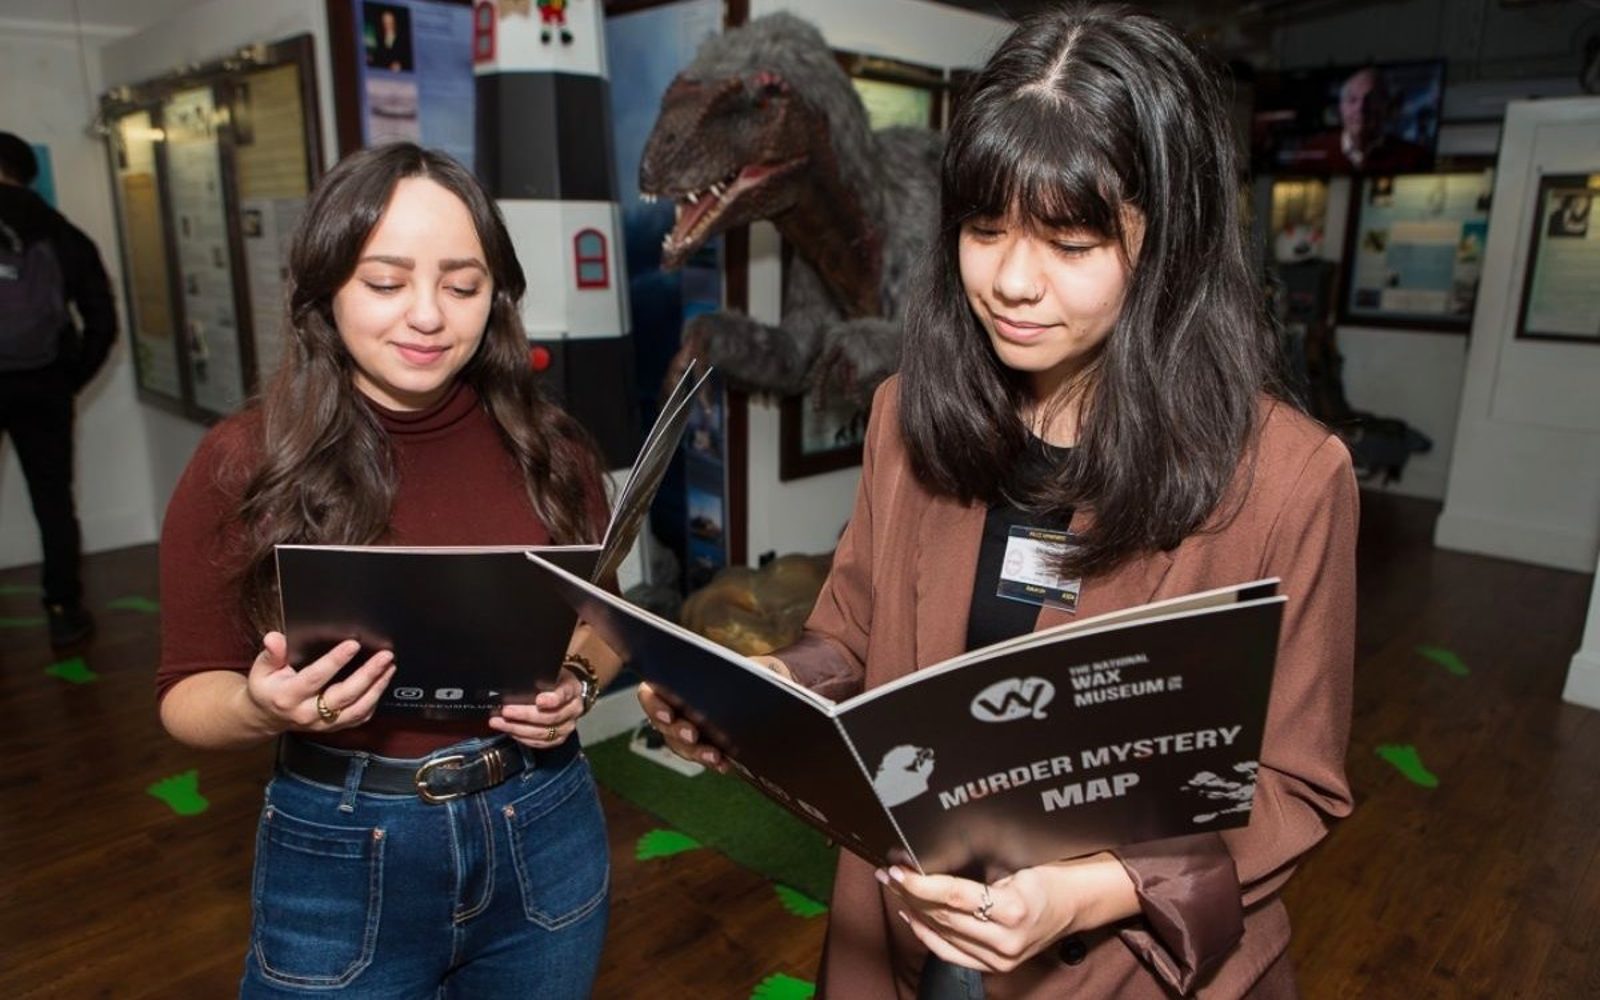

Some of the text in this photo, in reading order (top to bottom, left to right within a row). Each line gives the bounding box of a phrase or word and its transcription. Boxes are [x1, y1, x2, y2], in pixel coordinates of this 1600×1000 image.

[1069, 654, 1149, 676] THE NATIONAL
[1070, 669, 1122, 691] WAX
[1073, 678, 1165, 708] MUSEUM
[938, 726, 1242, 811] MURDER MYSTERY
[1041, 772, 1139, 812] MAP
